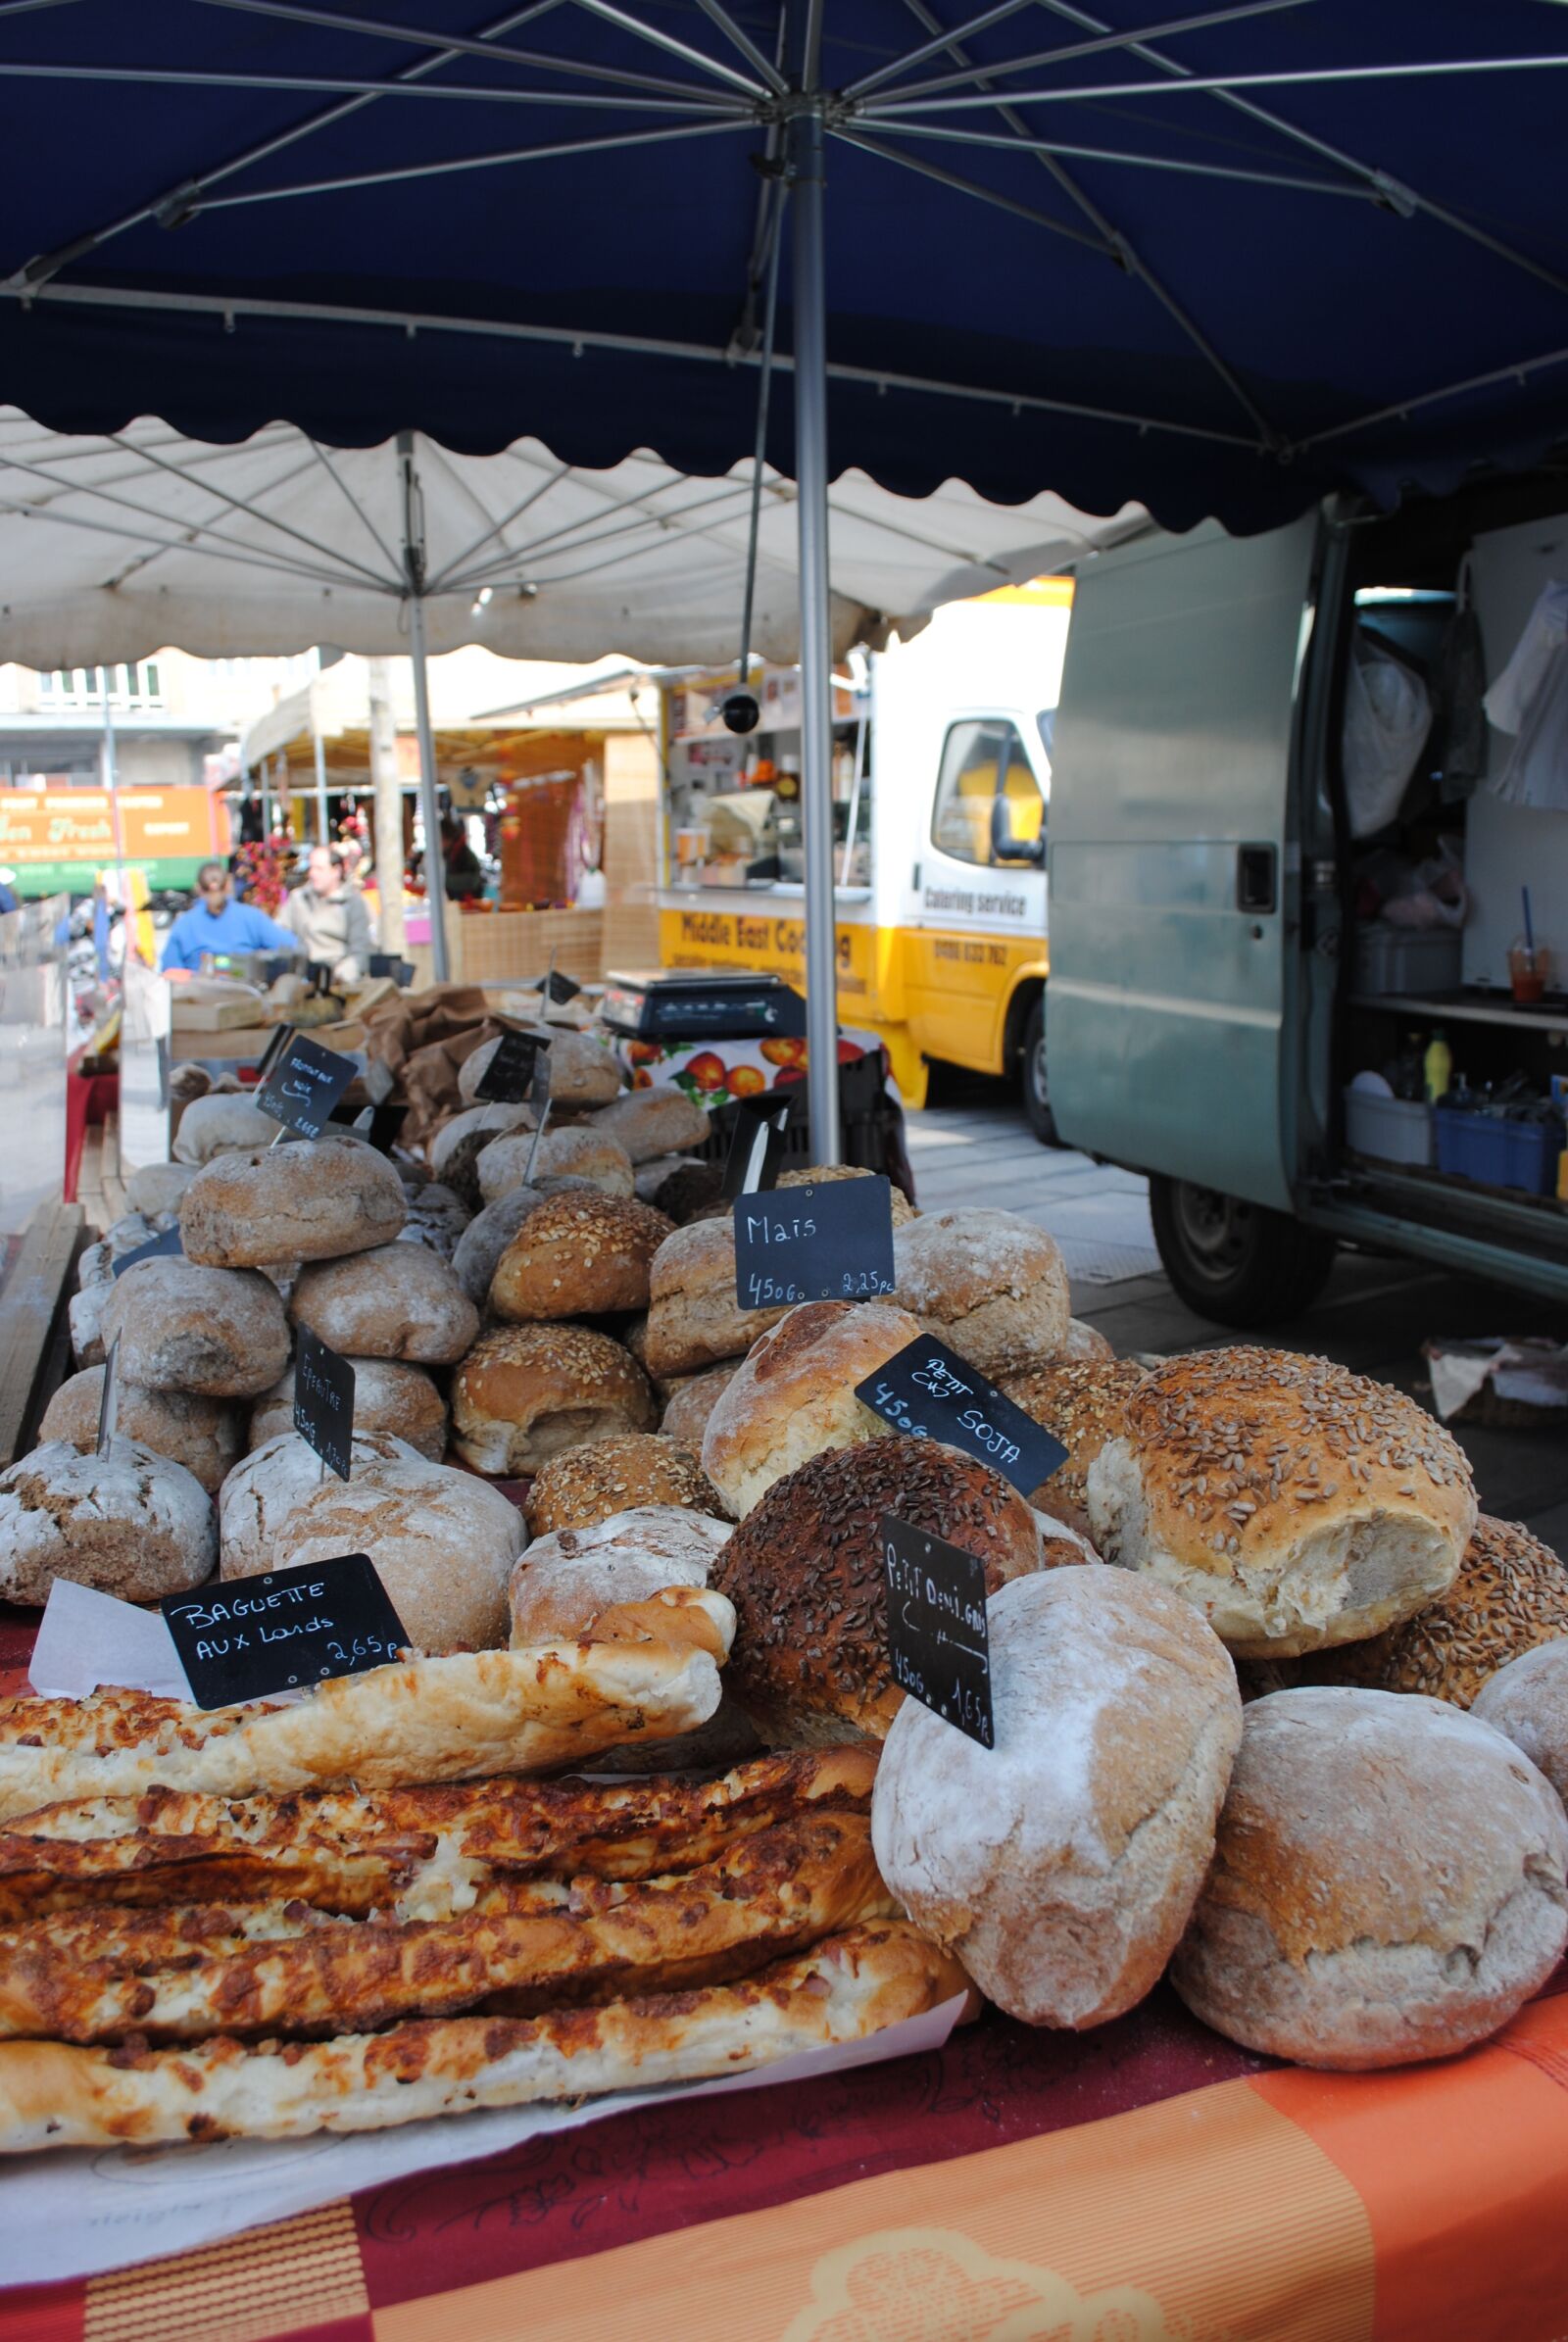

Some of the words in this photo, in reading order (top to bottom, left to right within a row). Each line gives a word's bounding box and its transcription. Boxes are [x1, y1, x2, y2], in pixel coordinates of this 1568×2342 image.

[924, 885, 974, 915] Catering
[978, 890, 1026, 916] service
[681, 911, 730, 947] Middle
[737, 916, 769, 950] East
[925, 1358, 974, 1395] PETIT
[956, 1410, 1021, 1464] SOJA
[170, 1582, 325, 1629] BAGUETTE
[196, 1634, 251, 1661] AUX
